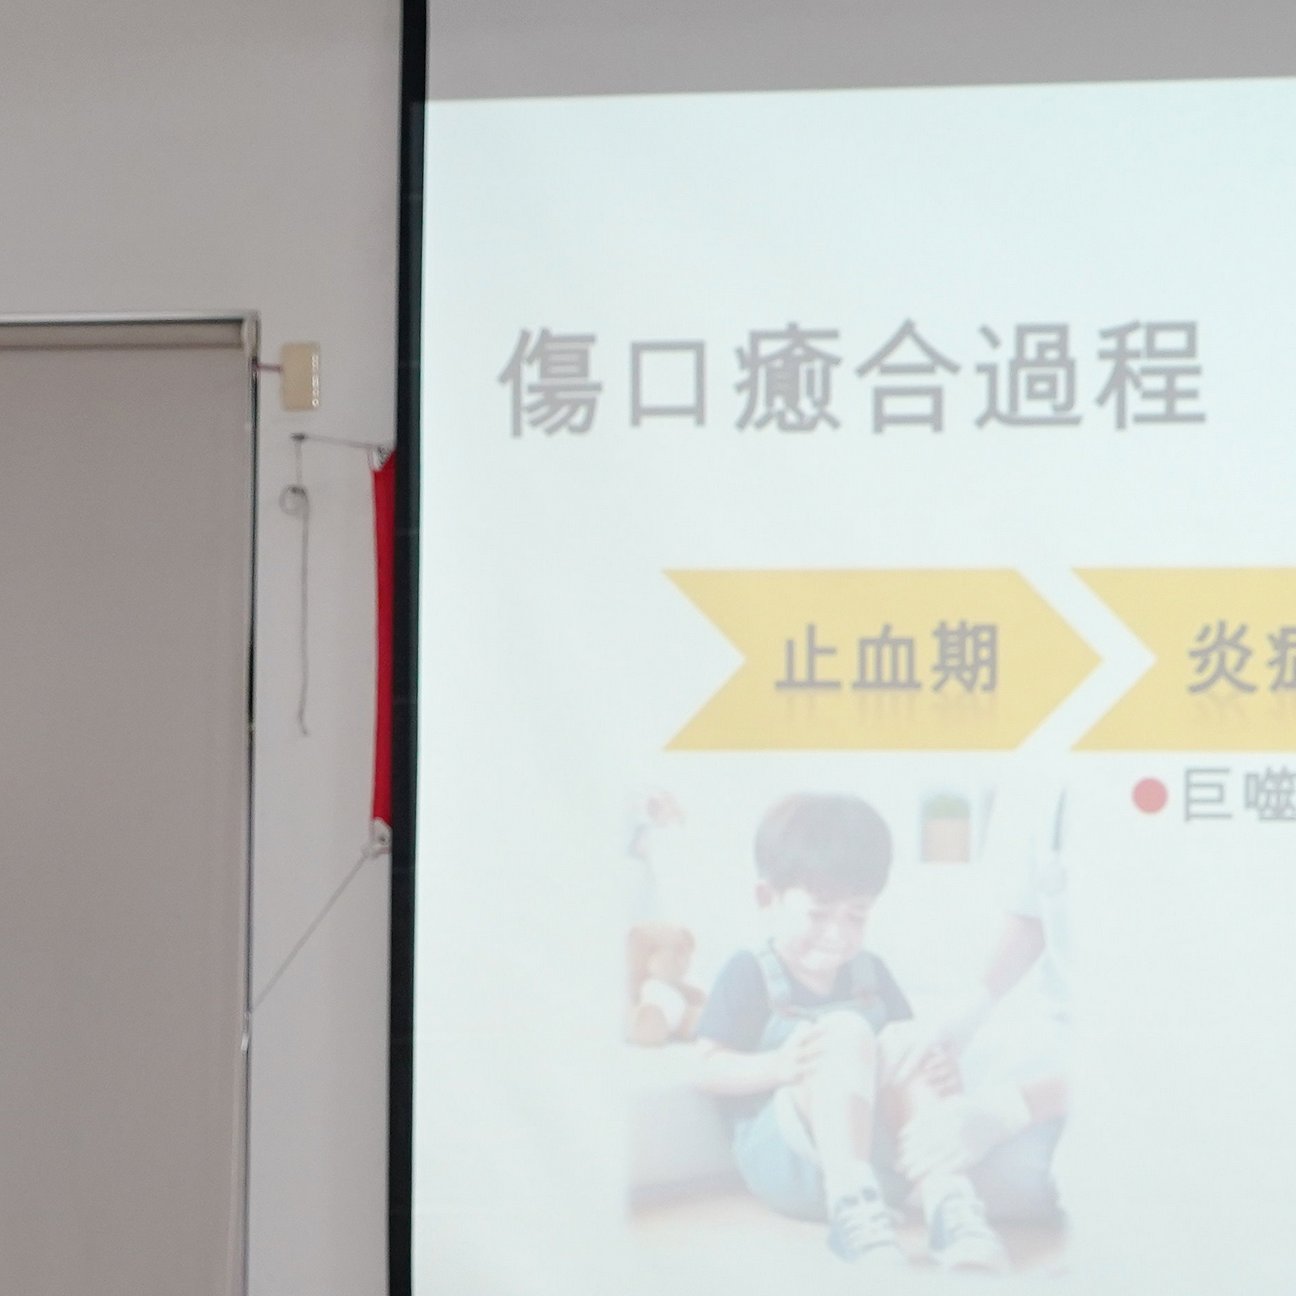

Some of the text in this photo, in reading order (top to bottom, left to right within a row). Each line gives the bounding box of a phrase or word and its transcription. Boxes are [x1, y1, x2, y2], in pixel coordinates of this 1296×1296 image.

[497, 320, 1206, 437] 傷口癒合過程
[774, 621, 999, 694] 止血期
